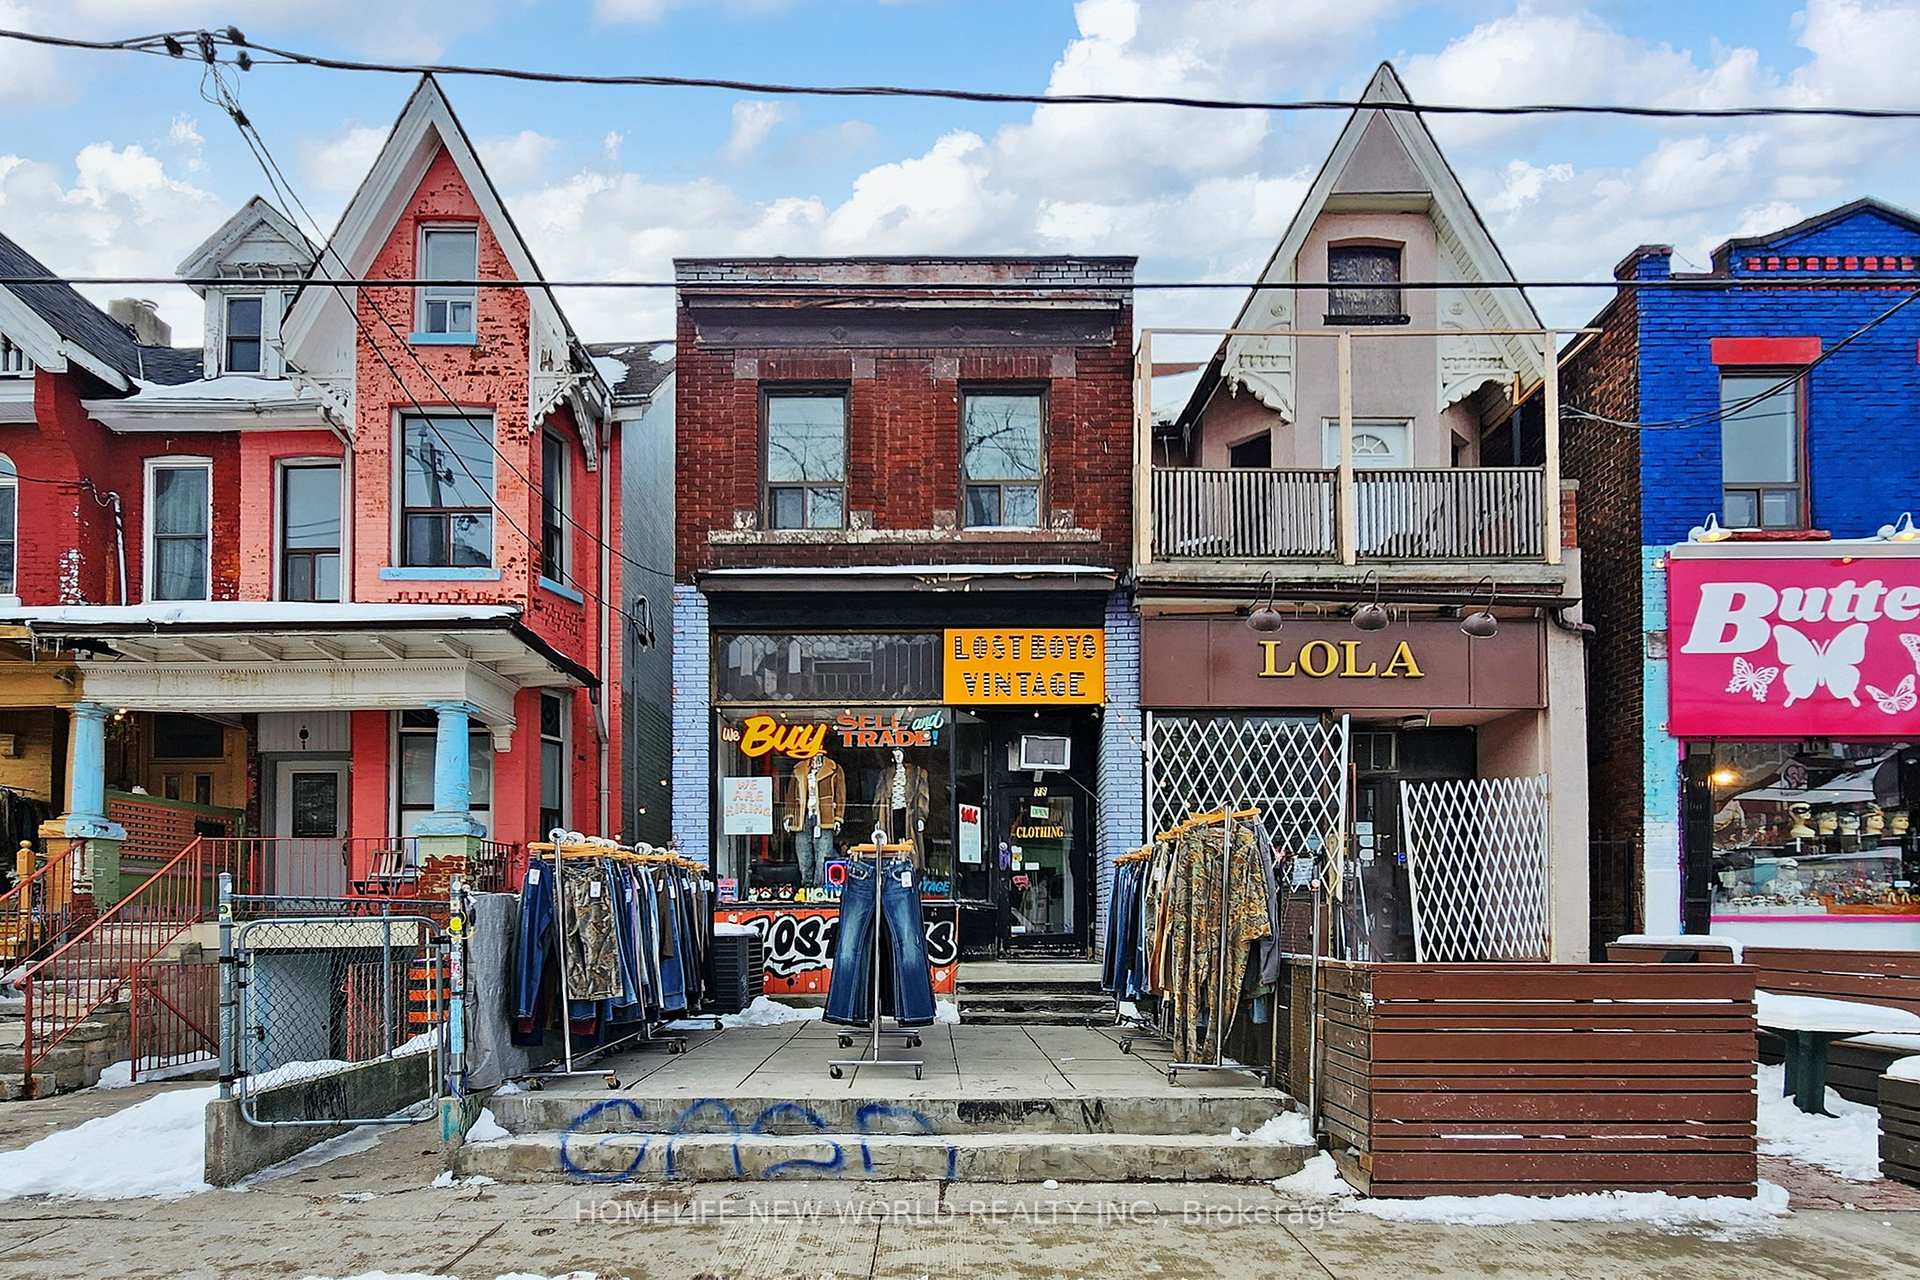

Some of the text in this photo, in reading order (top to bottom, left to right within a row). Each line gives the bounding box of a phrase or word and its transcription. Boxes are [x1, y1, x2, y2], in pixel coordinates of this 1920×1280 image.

[1680, 580, 1920, 654] Butte
[954, 634, 1097, 660] LOST BOYS
[1257, 640, 1425, 678] LOLA
[962, 672, 1086, 697] VINTAGE
[836, 711, 945, 732] SELL and
[722, 715, 828, 758] We Buy
[1016, 825, 1064, 839] CLOTHING
